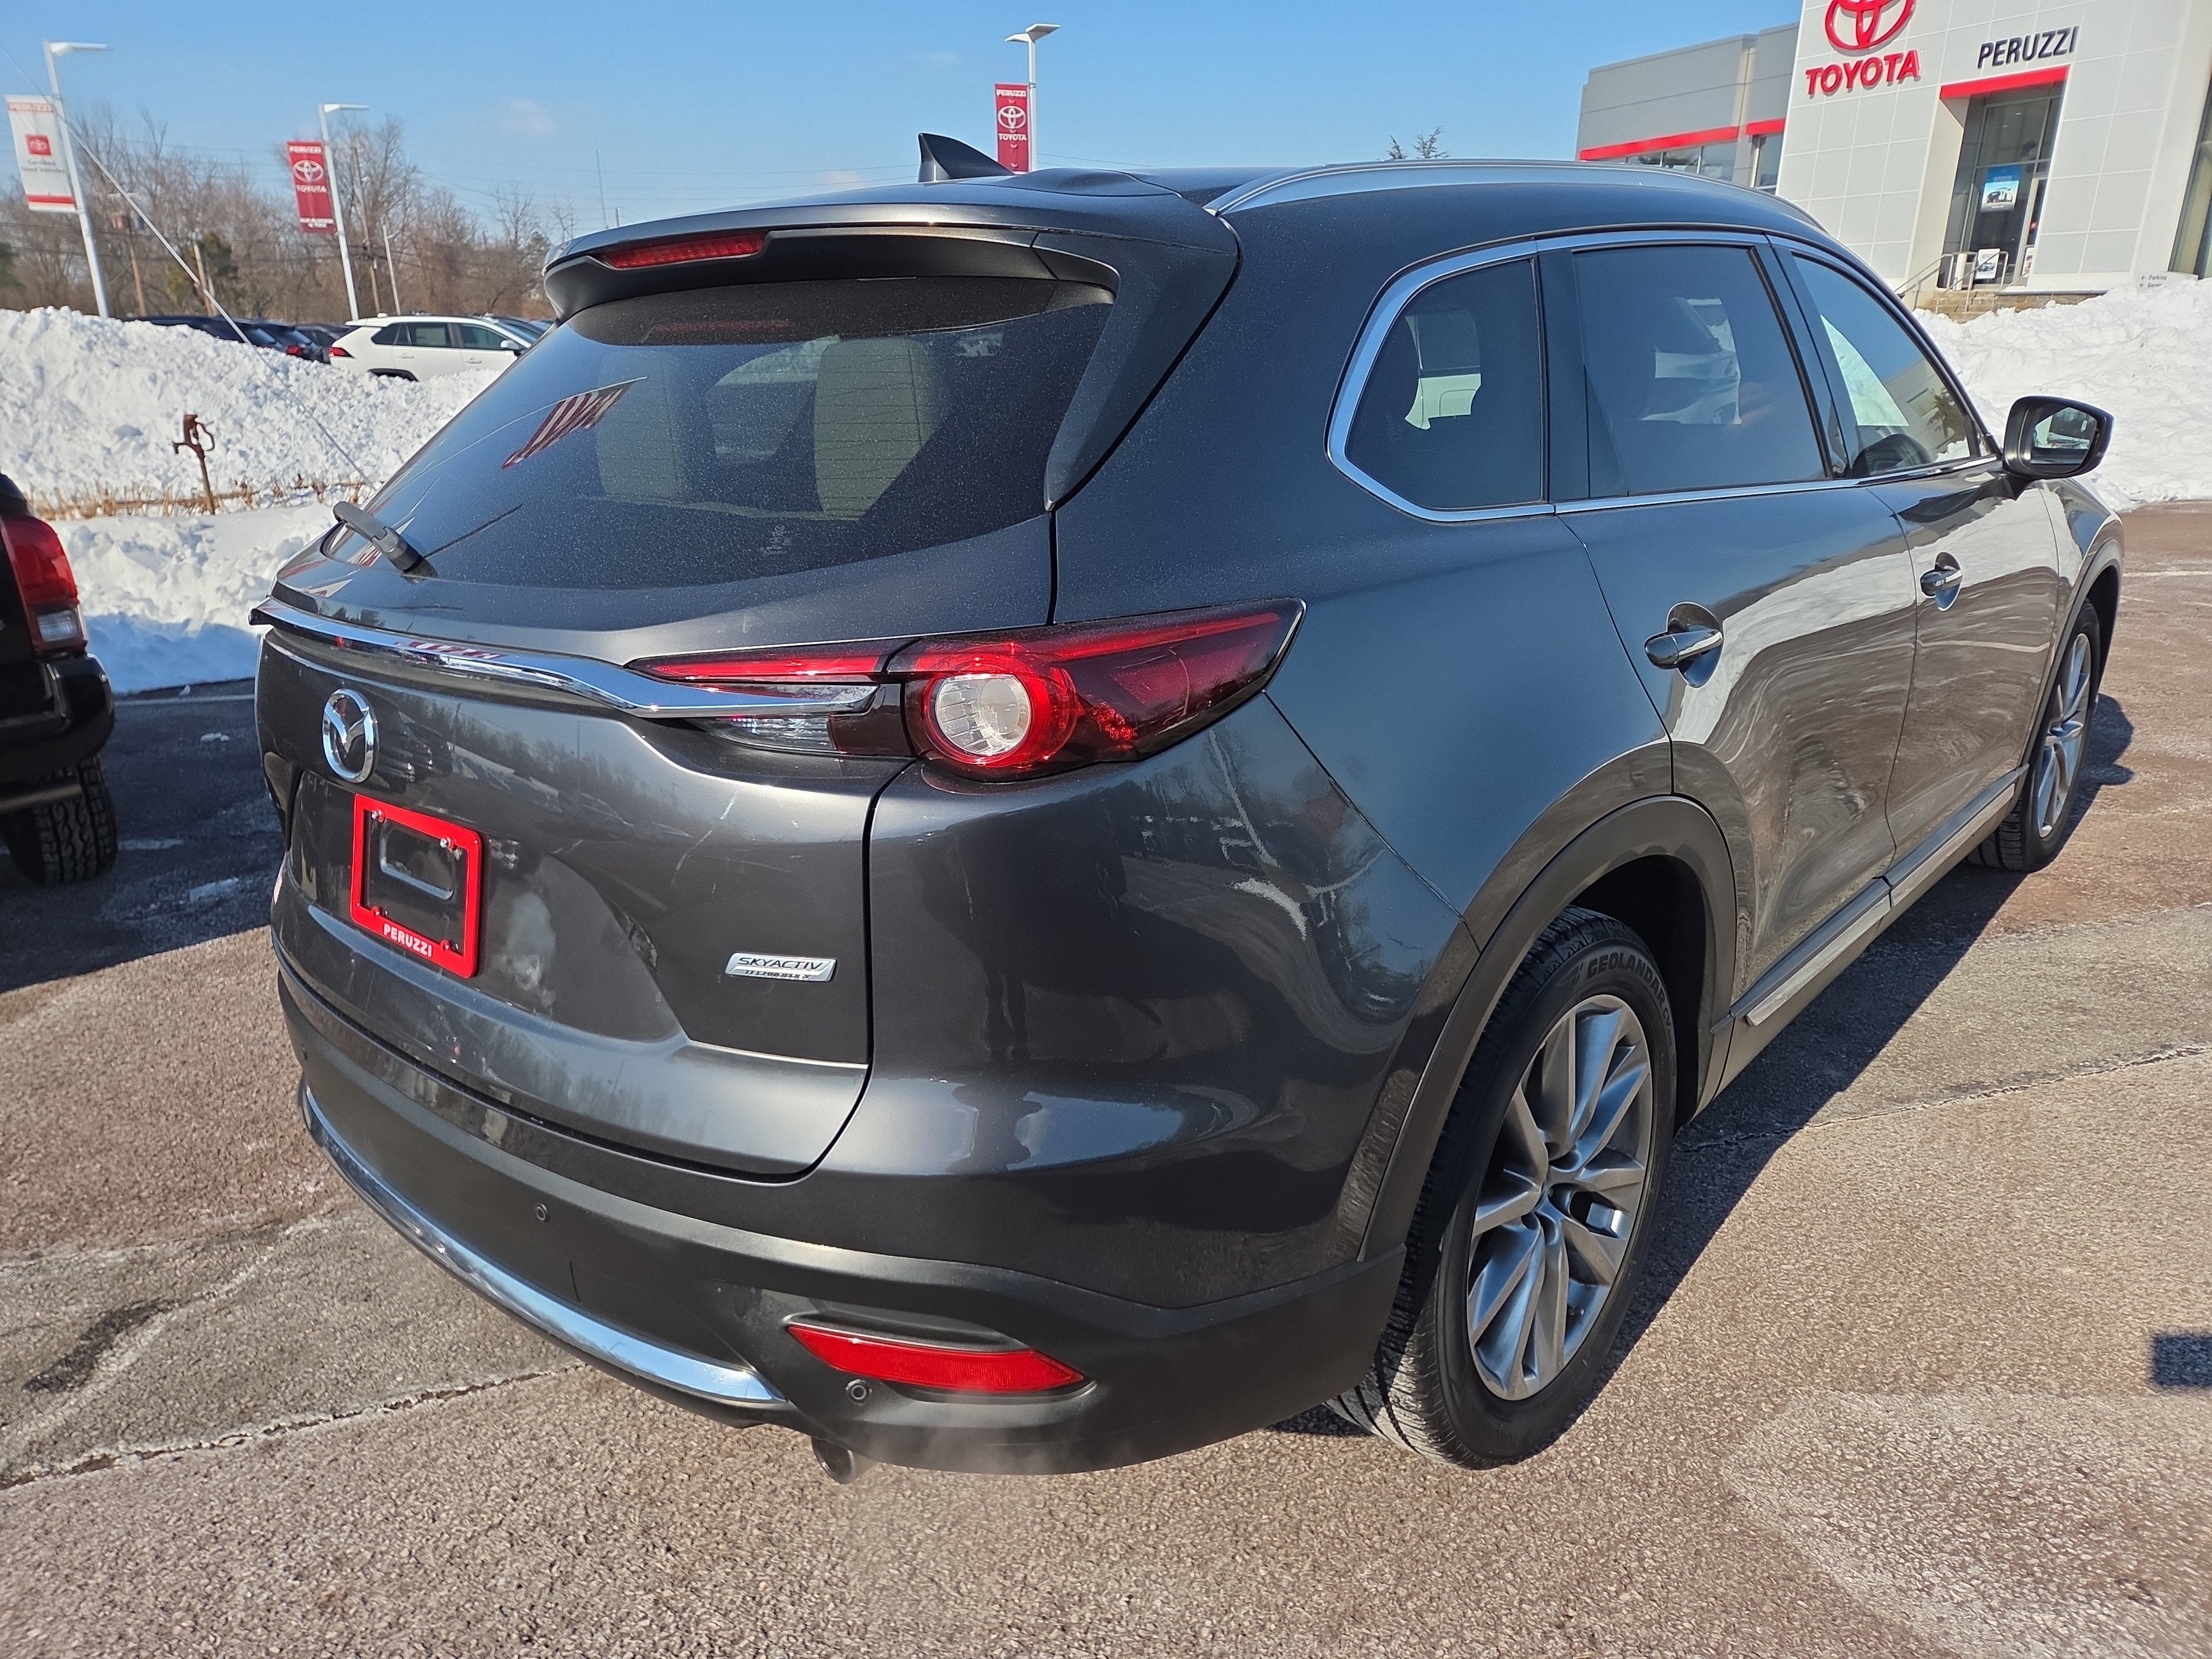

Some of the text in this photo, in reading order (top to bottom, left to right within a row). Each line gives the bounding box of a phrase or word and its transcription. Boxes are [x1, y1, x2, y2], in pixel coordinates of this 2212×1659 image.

[1977, 25, 2079, 69] PERUZZI
[1805, 50, 1920, 98] TOYOTA
[998, 133, 1027, 142] TOYOTA
[383, 922, 433, 959] PERUZZI
[737, 957, 824, 970] SKYACTIV
[1587, 951, 1666, 1008] GEOLANDAR
